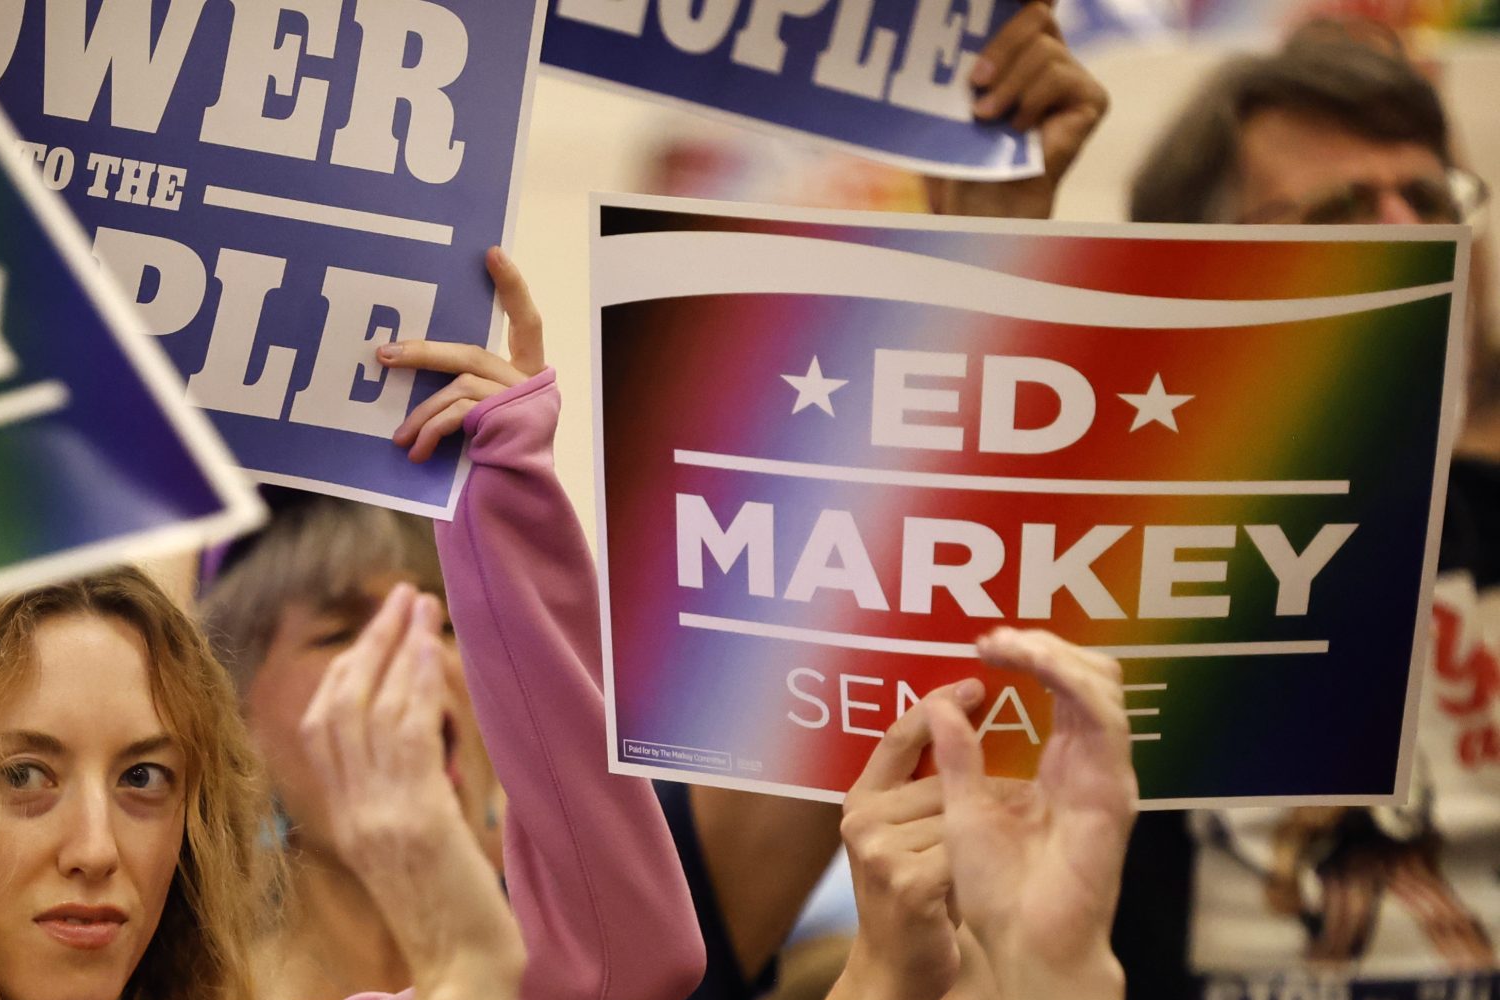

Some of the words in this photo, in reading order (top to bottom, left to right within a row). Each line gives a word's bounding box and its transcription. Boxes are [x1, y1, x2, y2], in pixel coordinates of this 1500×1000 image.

[86, 153, 187, 212] THE
[92, 226, 438, 441] PLE
[870, 348, 1097, 455] ED
[675, 491, 1360, 621] MARKEY
[628, 744, 642, 754] Paid
[642, 746, 651, 755] for
[651, 747, 660, 757] by
[660, 748, 671, 757] The
[786, 667, 1168, 746] SEAE
